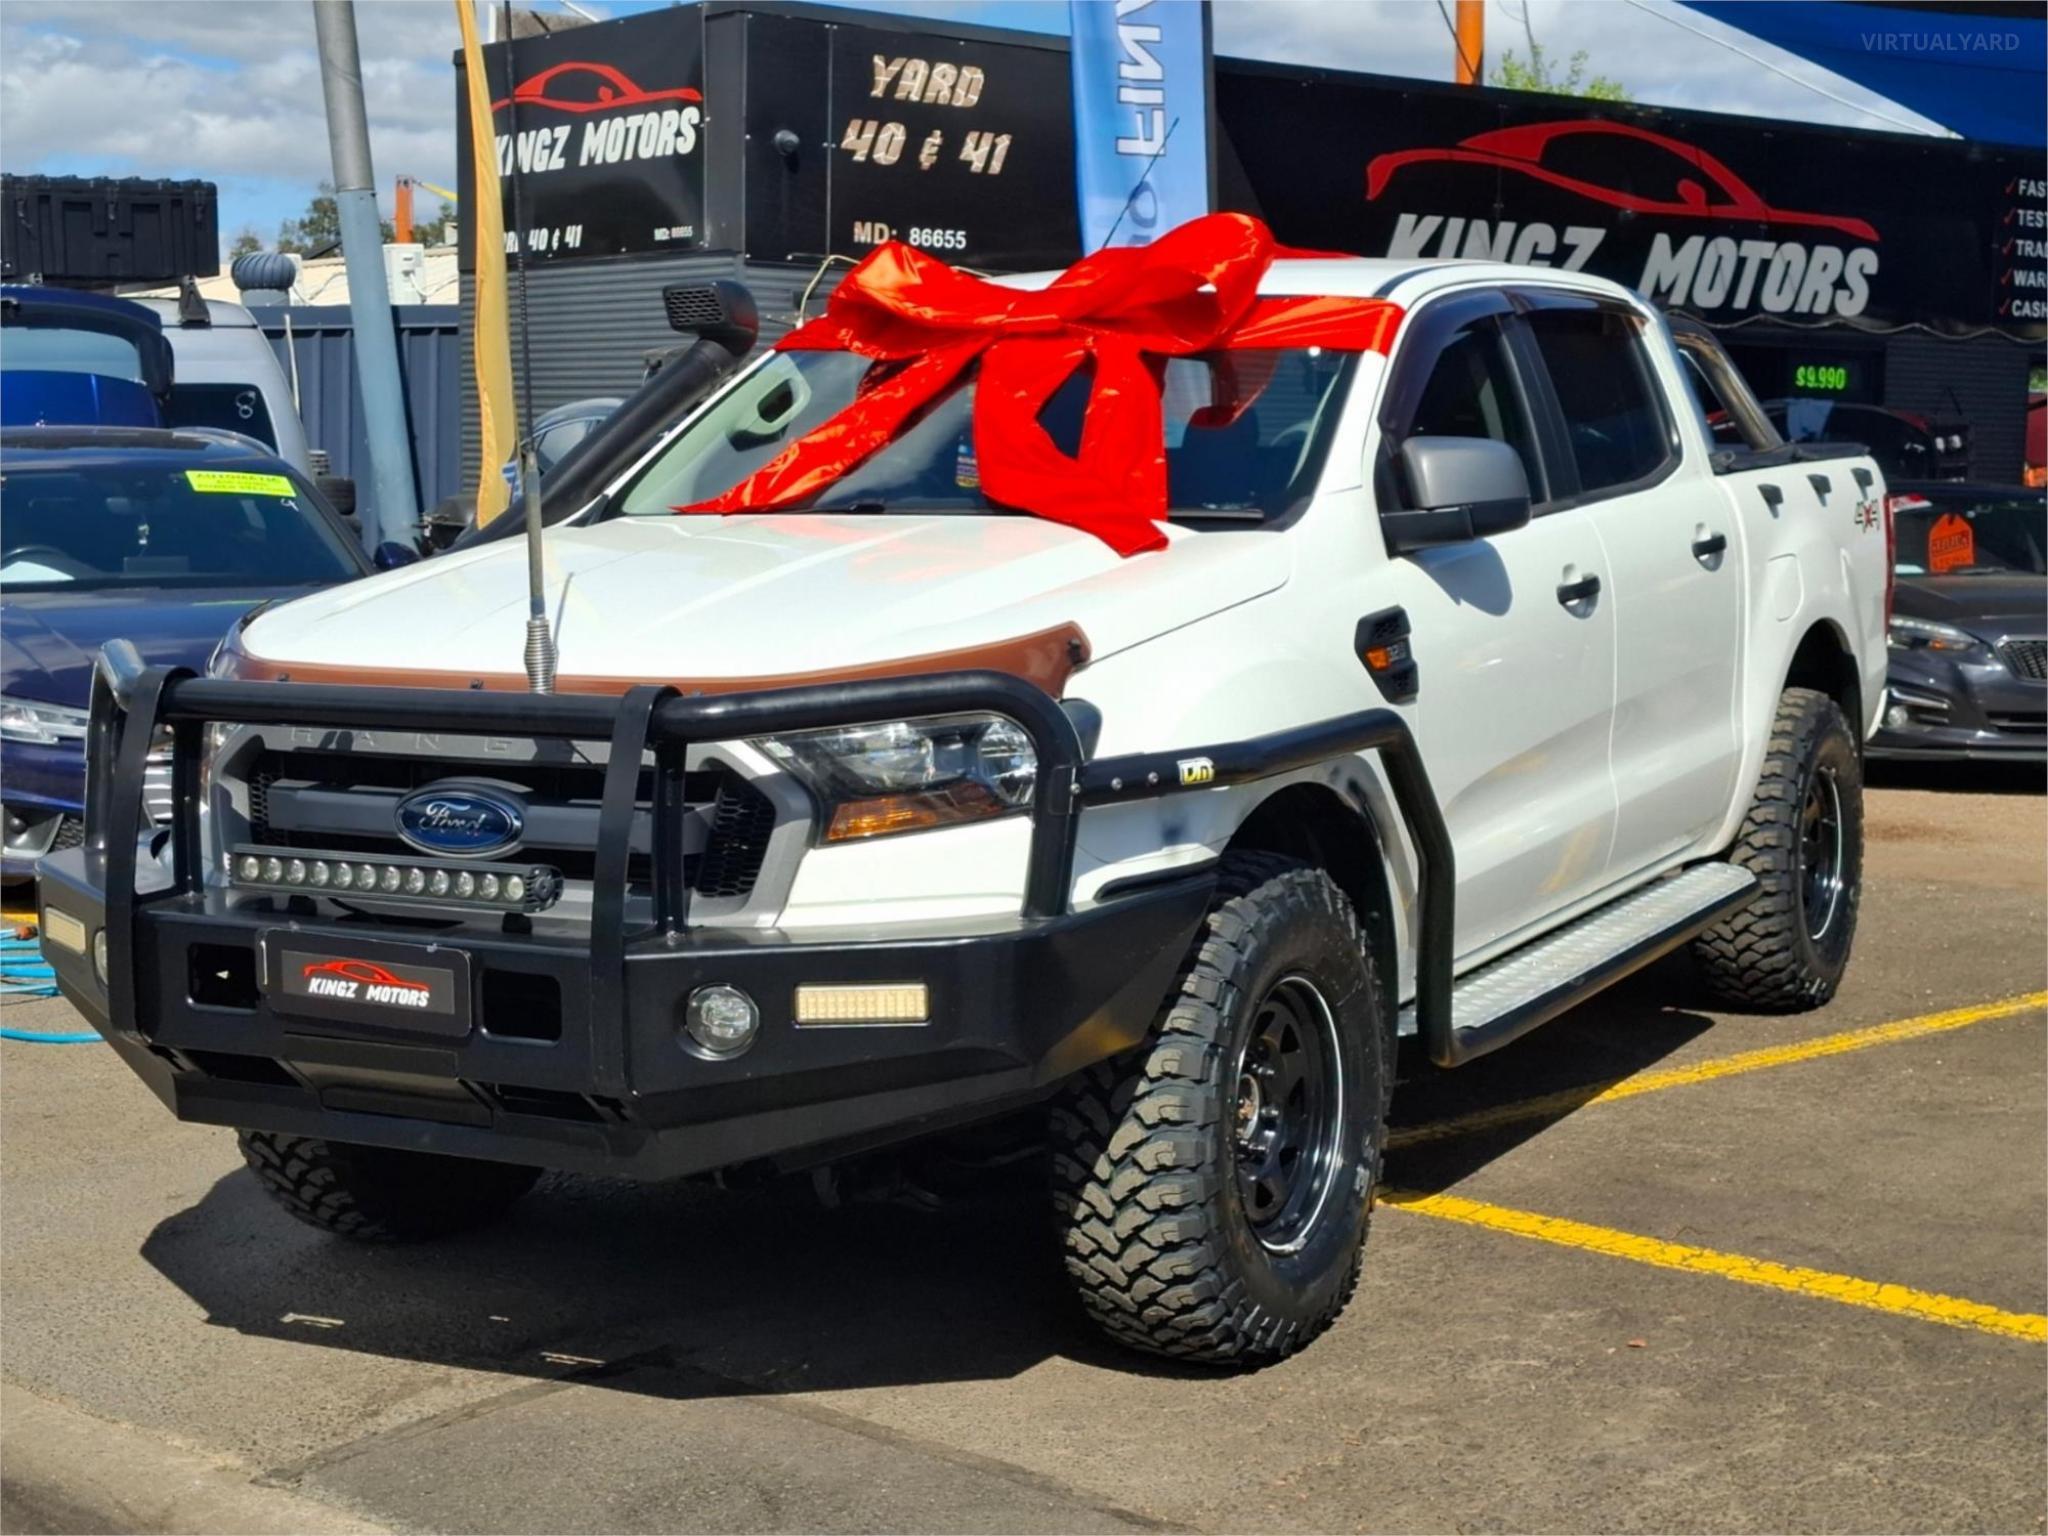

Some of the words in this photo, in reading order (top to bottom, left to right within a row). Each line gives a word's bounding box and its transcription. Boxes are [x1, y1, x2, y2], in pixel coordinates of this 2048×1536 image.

[870, 54, 985, 108] YARD
[579, 106, 700, 166] MOTORS
[840, 119, 907, 166] 40
[919, 129, 944, 171] &
[958, 131, 1013, 175] 41
[2018, 178, 2047, 198] FAS
[527, 227, 549, 251] 40
[564, 224, 583, 248] 41
[909, 227, 967, 249] 86655
[1637, 232, 1879, 317] MOTORS
[419, 801, 486, 837] Ford
[307, 977, 359, 998] KINGZ
[366, 984, 430, 1008] MOTORS
